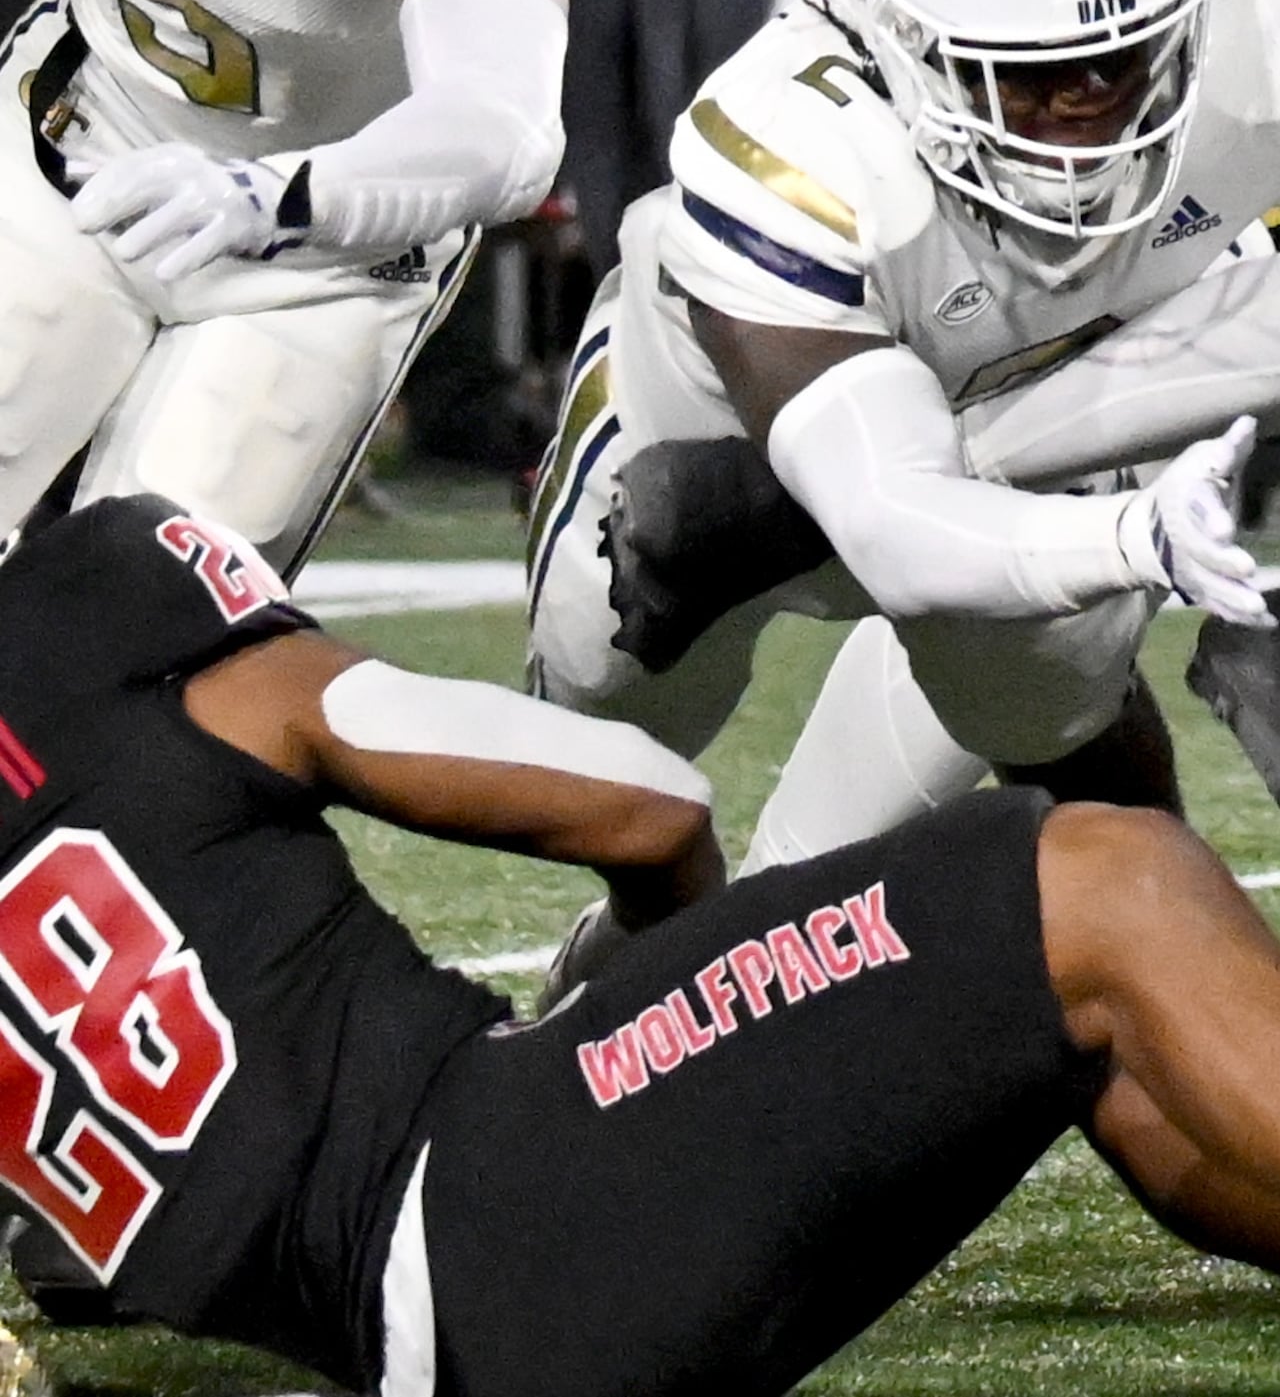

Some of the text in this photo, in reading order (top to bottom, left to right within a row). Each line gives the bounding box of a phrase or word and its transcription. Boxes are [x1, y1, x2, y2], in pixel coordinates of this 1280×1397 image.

[369, 264, 432, 284] adidas
[1150, 212, 1223, 250] adidas
[0, 826, 238, 1288] 28
[577, 881, 911, 1109] WOLFPACK
